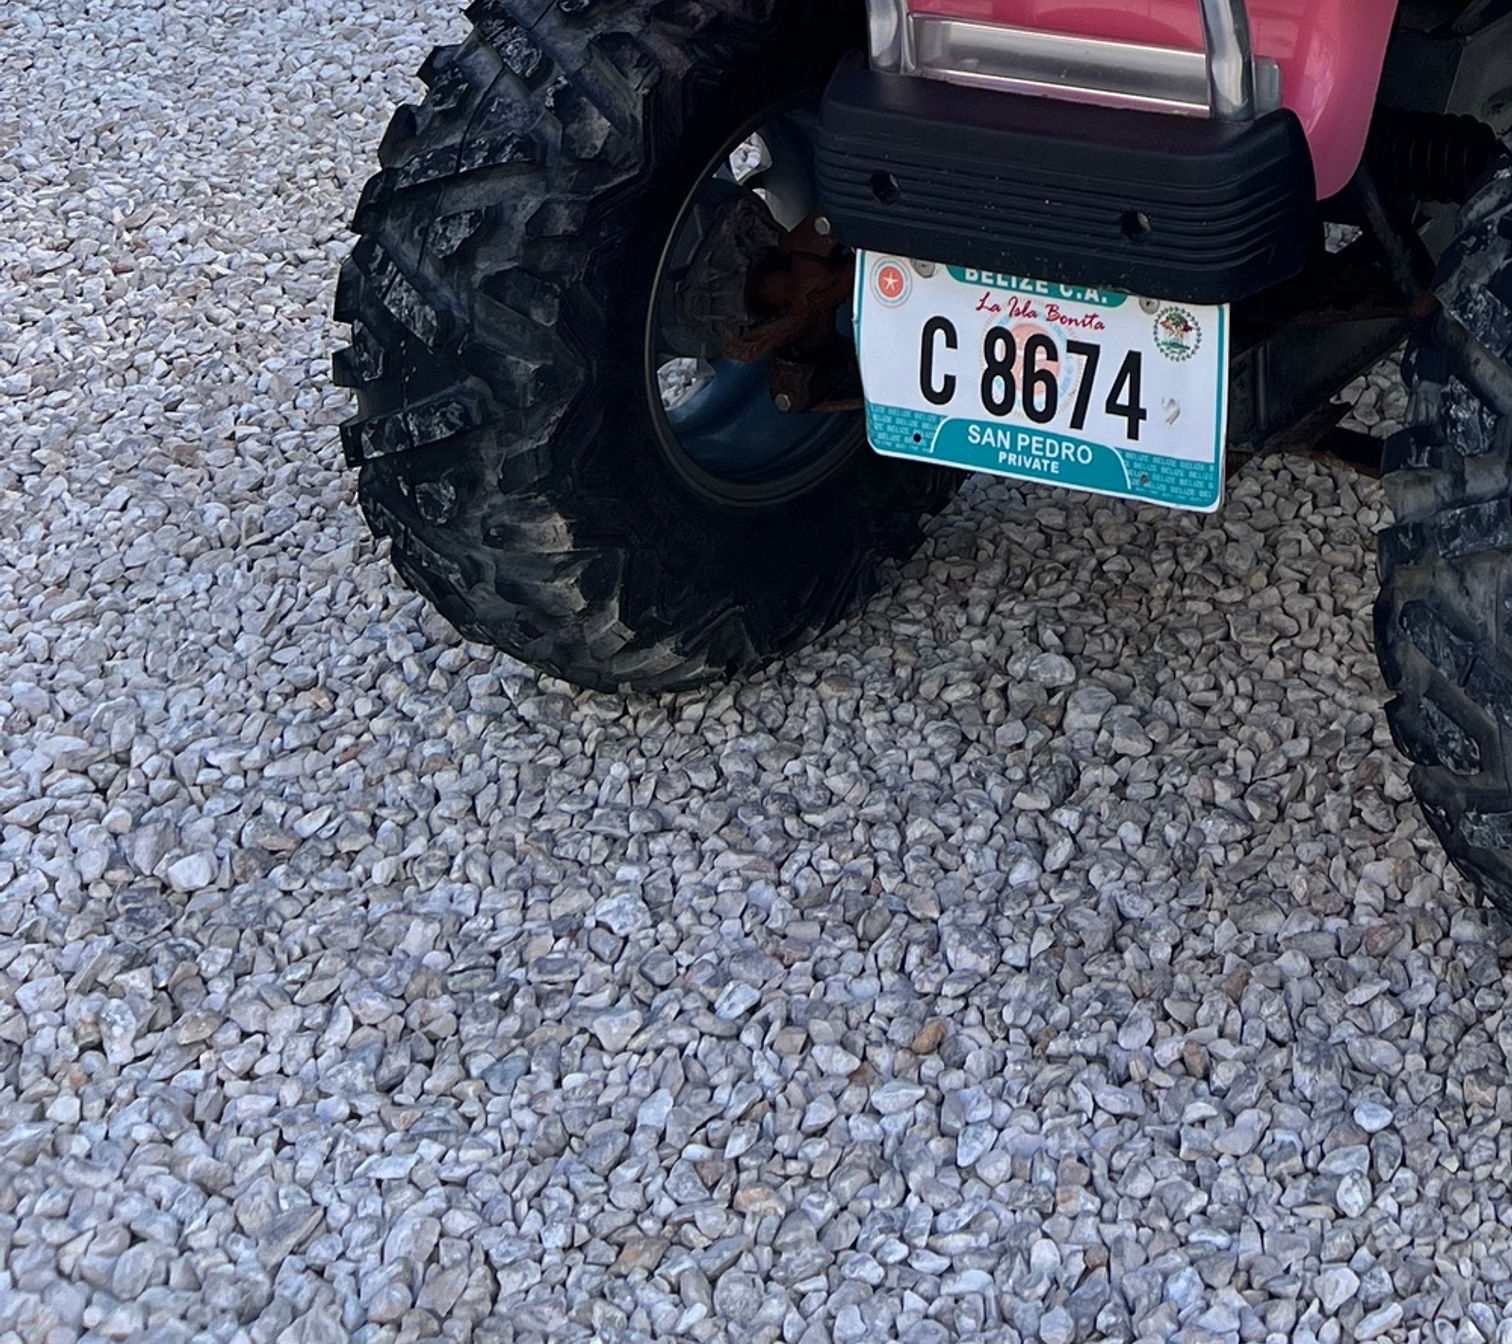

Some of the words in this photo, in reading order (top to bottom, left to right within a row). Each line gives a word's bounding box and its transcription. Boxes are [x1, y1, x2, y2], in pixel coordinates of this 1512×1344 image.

[964, 268, 1049, 294] BELIZE
[1059, 283, 1108, 304] C.A.
[975, 291, 1002, 313] La
[1008, 296, 1038, 318] Isla
[1045, 303, 1106, 330] Bonita
[919, 315, 959, 406] C
[980, 326, 1148, 441] 8674
[968, 424, 1011, 450] SAN
[1017, 433, 1093, 465] PEDRO
[999, 451, 1059, 474] PRIVATE
